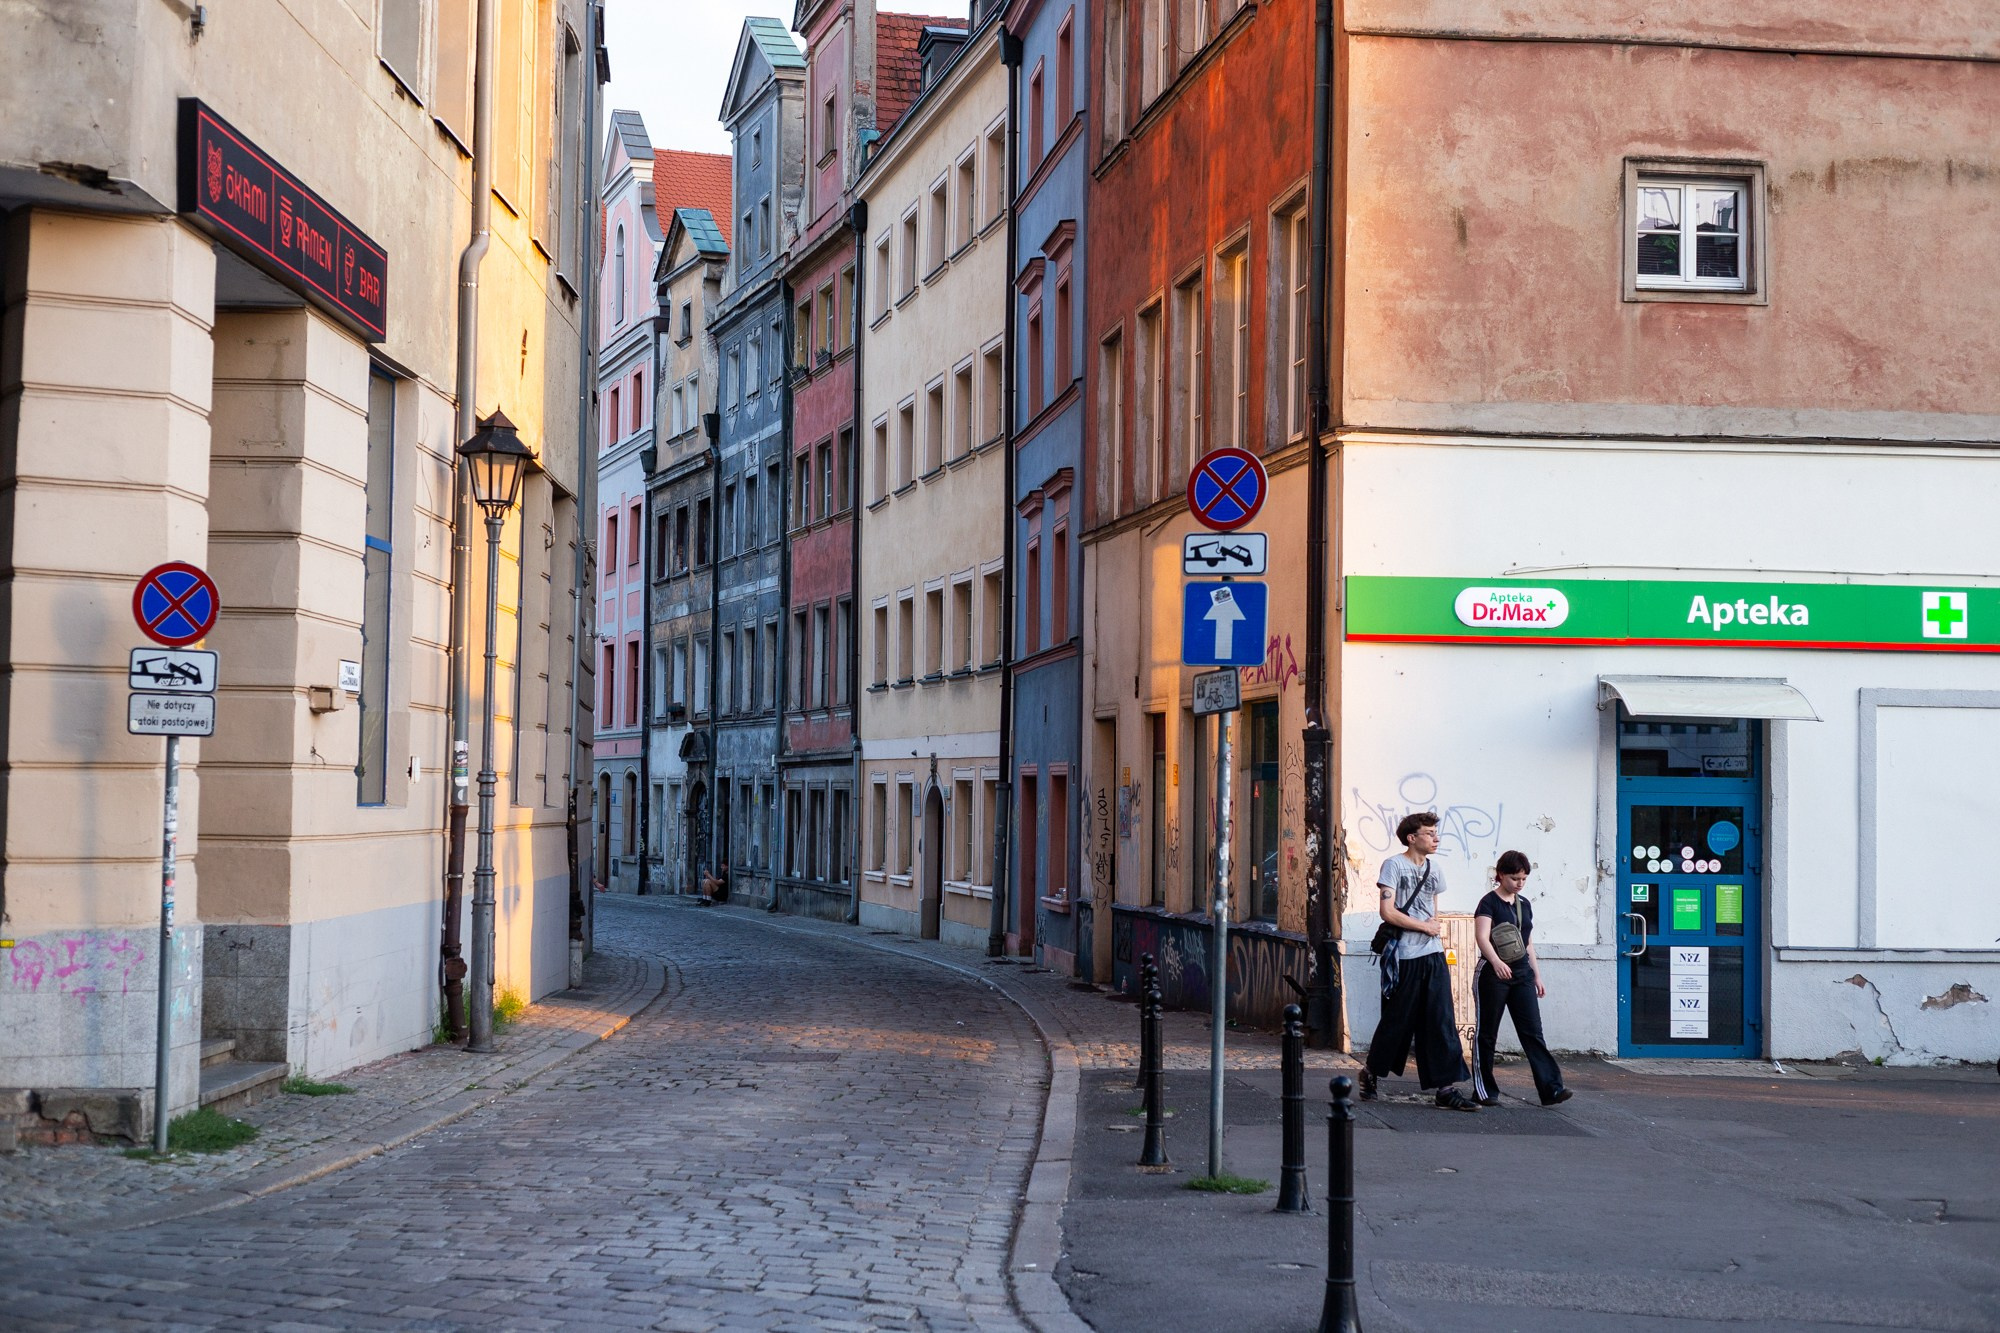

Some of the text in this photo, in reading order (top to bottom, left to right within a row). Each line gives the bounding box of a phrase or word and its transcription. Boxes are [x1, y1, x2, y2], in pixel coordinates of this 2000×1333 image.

[296, 217, 332, 273] RAMEN
[359, 266, 380, 307] BAR
[1490, 592, 1533, 604] Apteka
[1473, 603, 1547, 622] Dr.Max
[1686, 595, 1809, 631] Apteka
[147, 699, 196, 712] Nie dotyczy
[134, 716, 209, 729] atoki postojowej
[1679, 952, 1701, 963] NFZ
[1679, 998, 1701, 1009] NFZ
